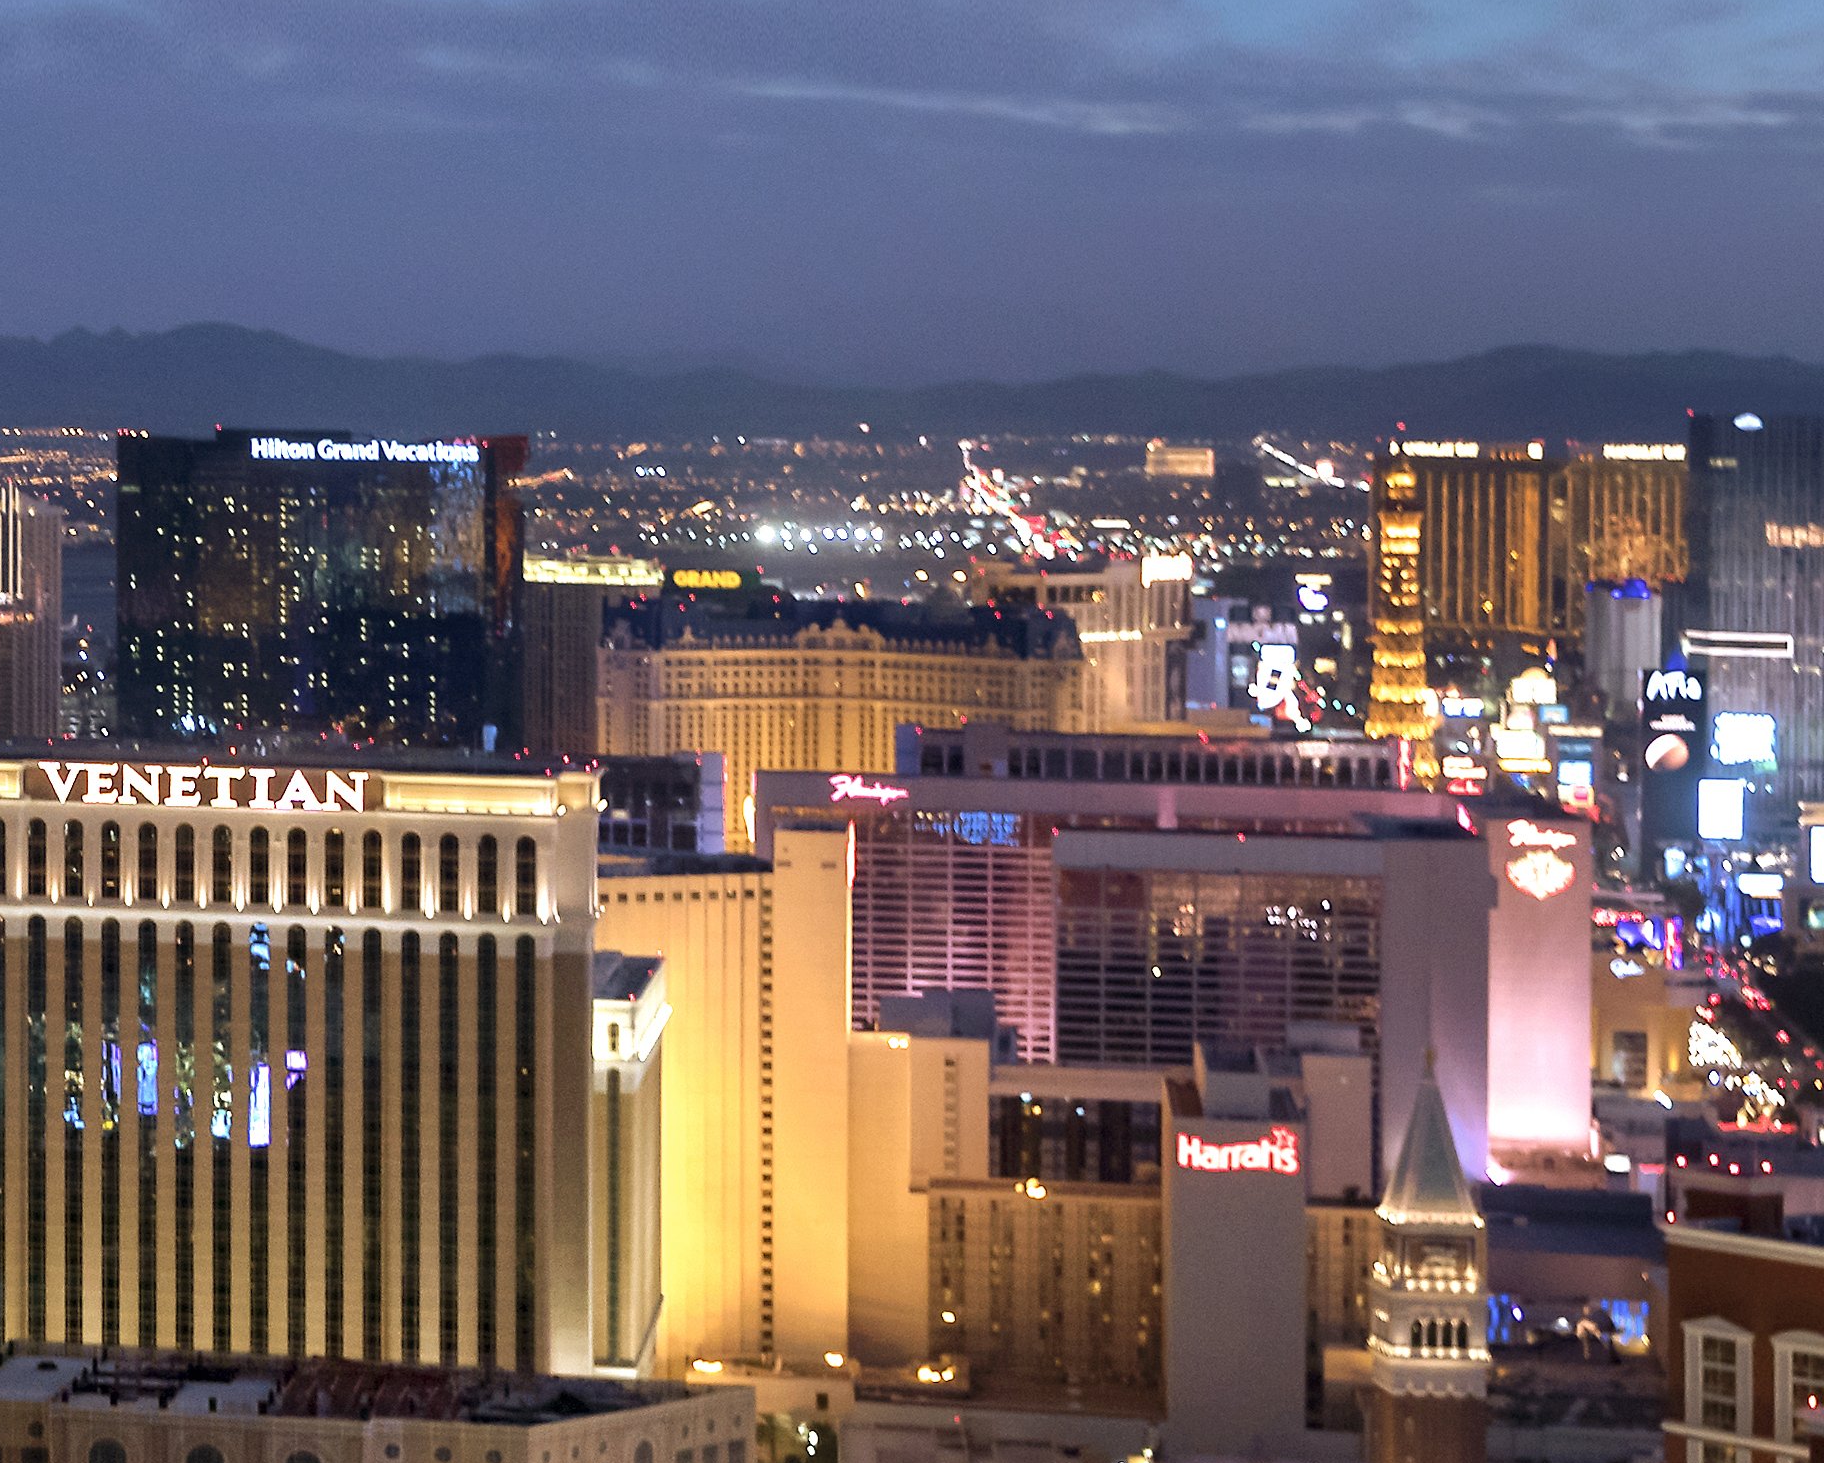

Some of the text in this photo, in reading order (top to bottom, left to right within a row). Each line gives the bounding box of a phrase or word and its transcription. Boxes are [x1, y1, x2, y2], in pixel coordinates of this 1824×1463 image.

[251, 438, 479, 463] Hilton Grand Vacations
[673, 570, 742, 589] GRAND
[38, 760, 369, 814] VENETIAN
